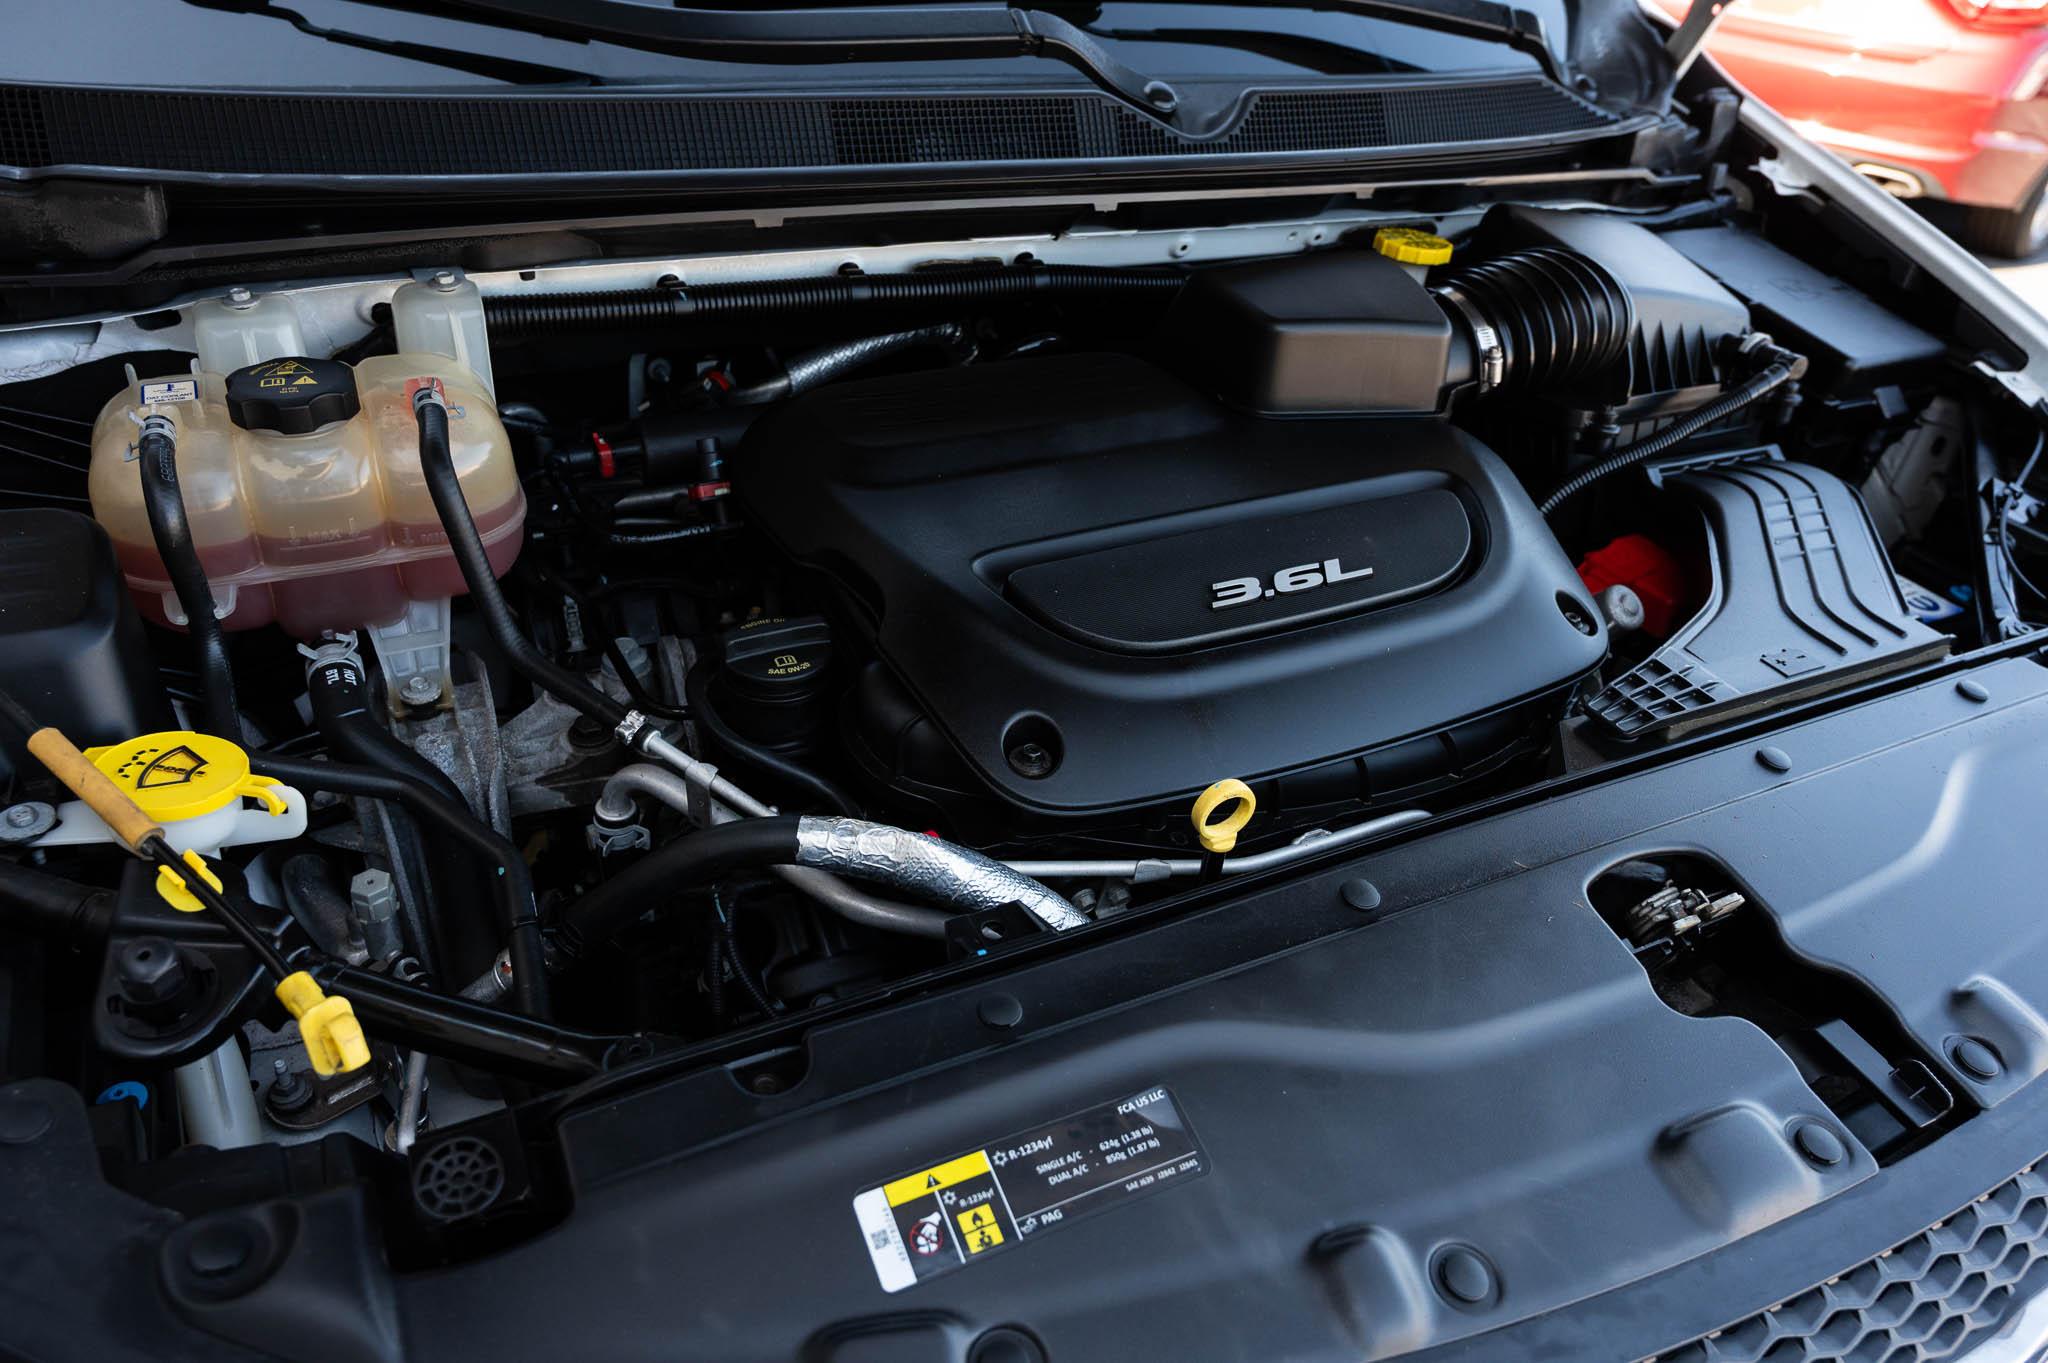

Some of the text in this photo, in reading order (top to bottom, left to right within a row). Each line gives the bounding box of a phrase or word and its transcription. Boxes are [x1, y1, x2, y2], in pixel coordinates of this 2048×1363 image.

[1212, 558, 1374, 609] 3.6L
[325, 668, 340, 685] BTL
[343, 668, 358, 686] HOT
[1117, 1089, 1165, 1115] FCA US LLC
[1008, 1135, 1053, 1160] R-1234yf
[1036, 1157, 1065, 1174] SINGLE
[1066, 1150, 1083, 1164] A/C
[1099, 1139, 1121, 1151] 624g
[1141, 1124, 1154, 1136] lb)
[1048, 1170, 1072, 1186] DUAL
[1072, 1163, 1089, 1177] A/C
[1105, 1151, 1127, 1164] 850g
[1147, 1136, 1160, 1149] lb)
[1040, 1208, 1063, 1225] PAG
